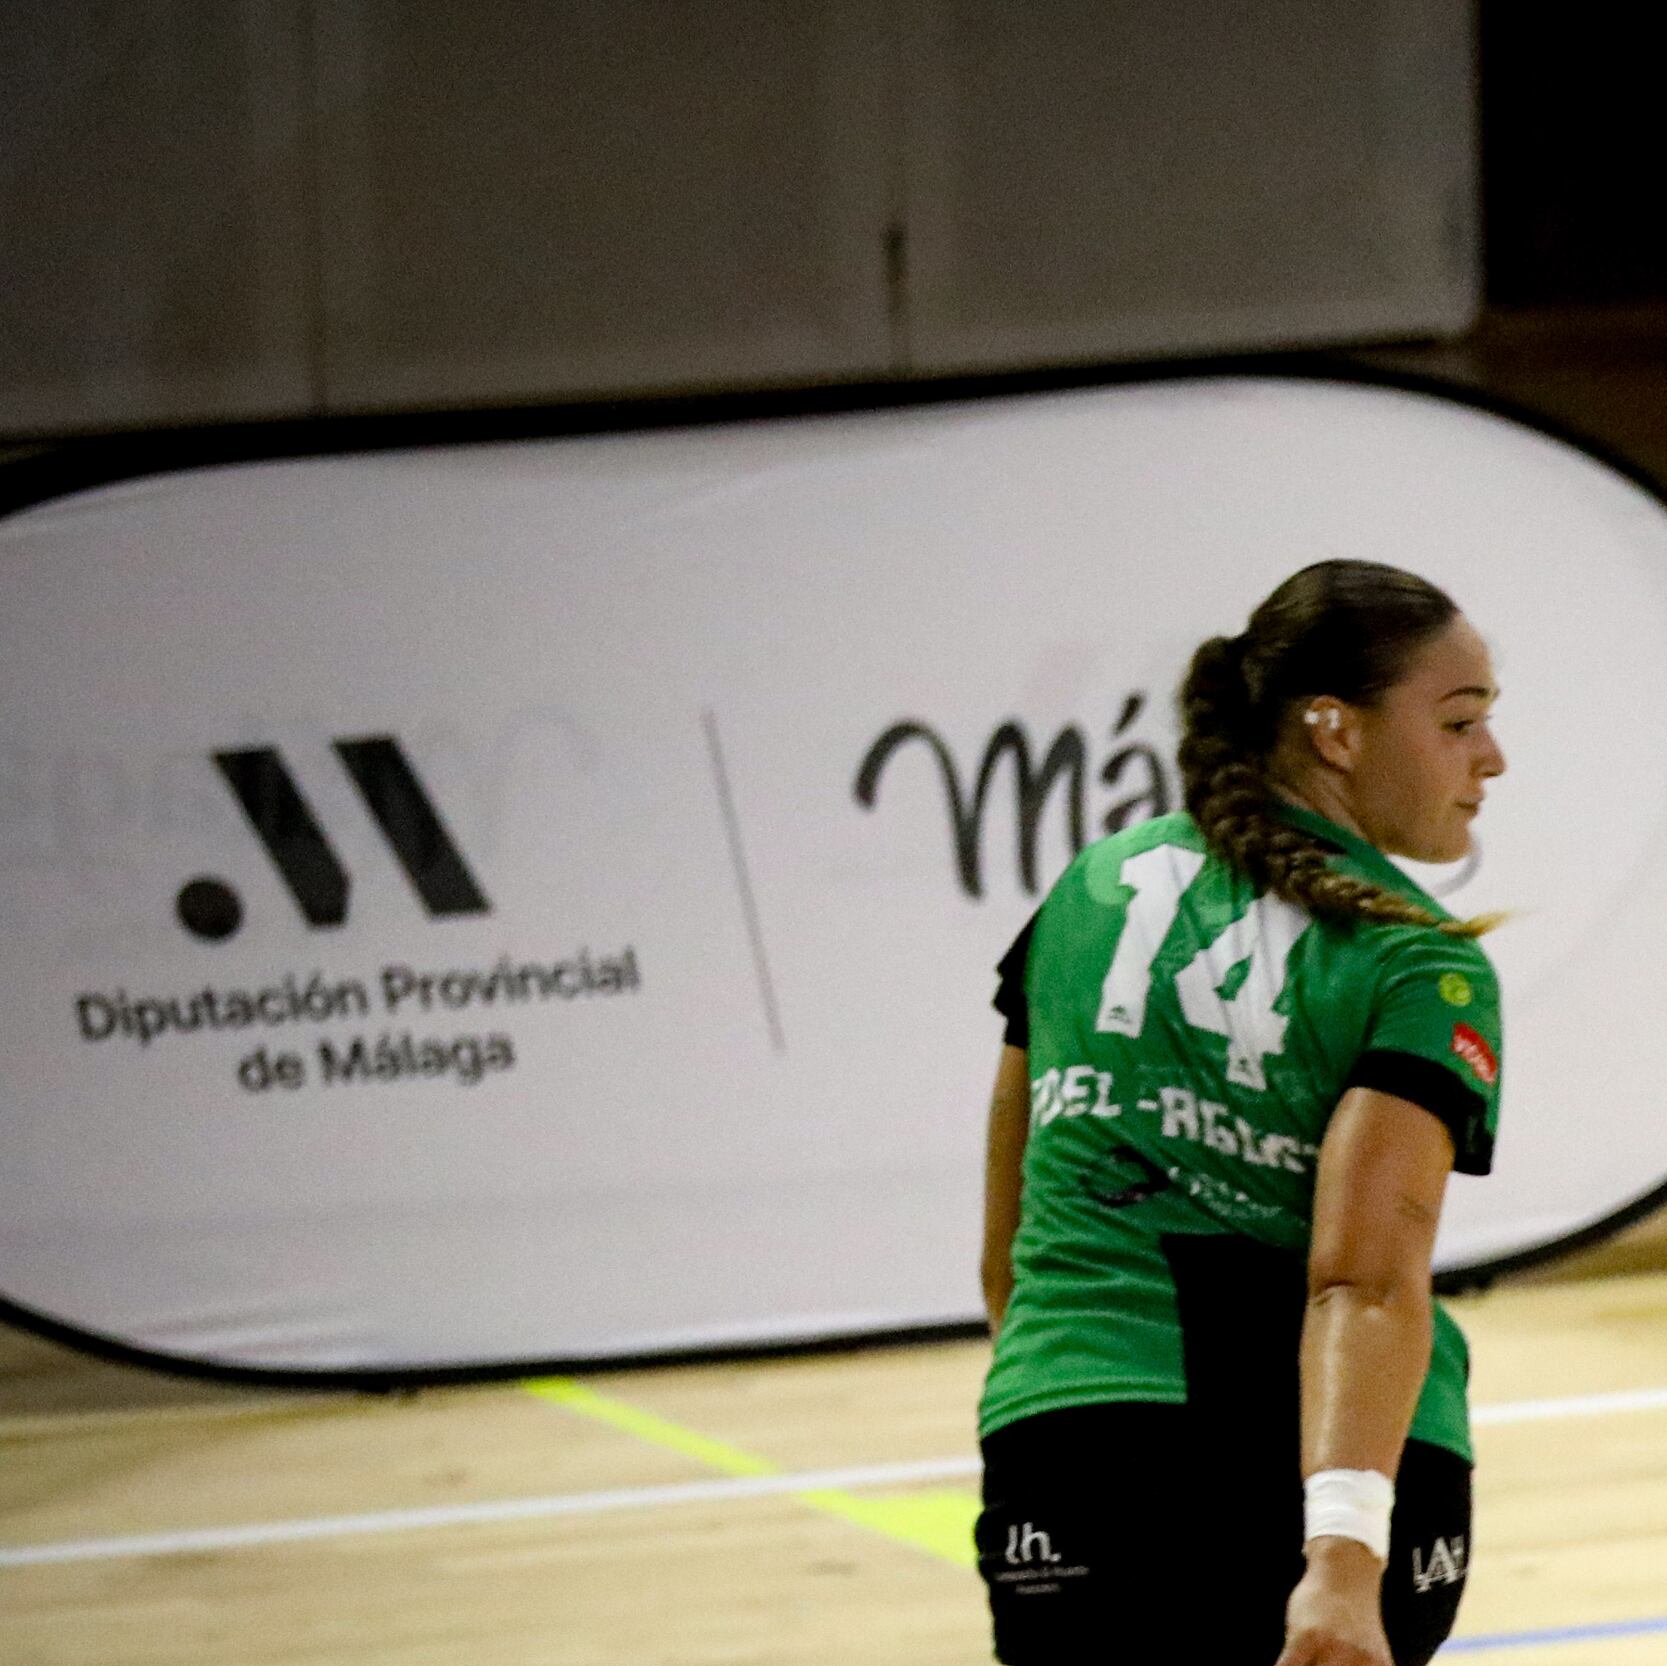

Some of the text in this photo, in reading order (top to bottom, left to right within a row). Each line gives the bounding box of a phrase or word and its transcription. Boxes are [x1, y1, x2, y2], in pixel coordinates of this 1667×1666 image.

[76, 945, 641, 1045] Diputación Provincial
[1094, 843, 1312, 1092] 14
[236, 1029, 517, 1092] de Málaga
